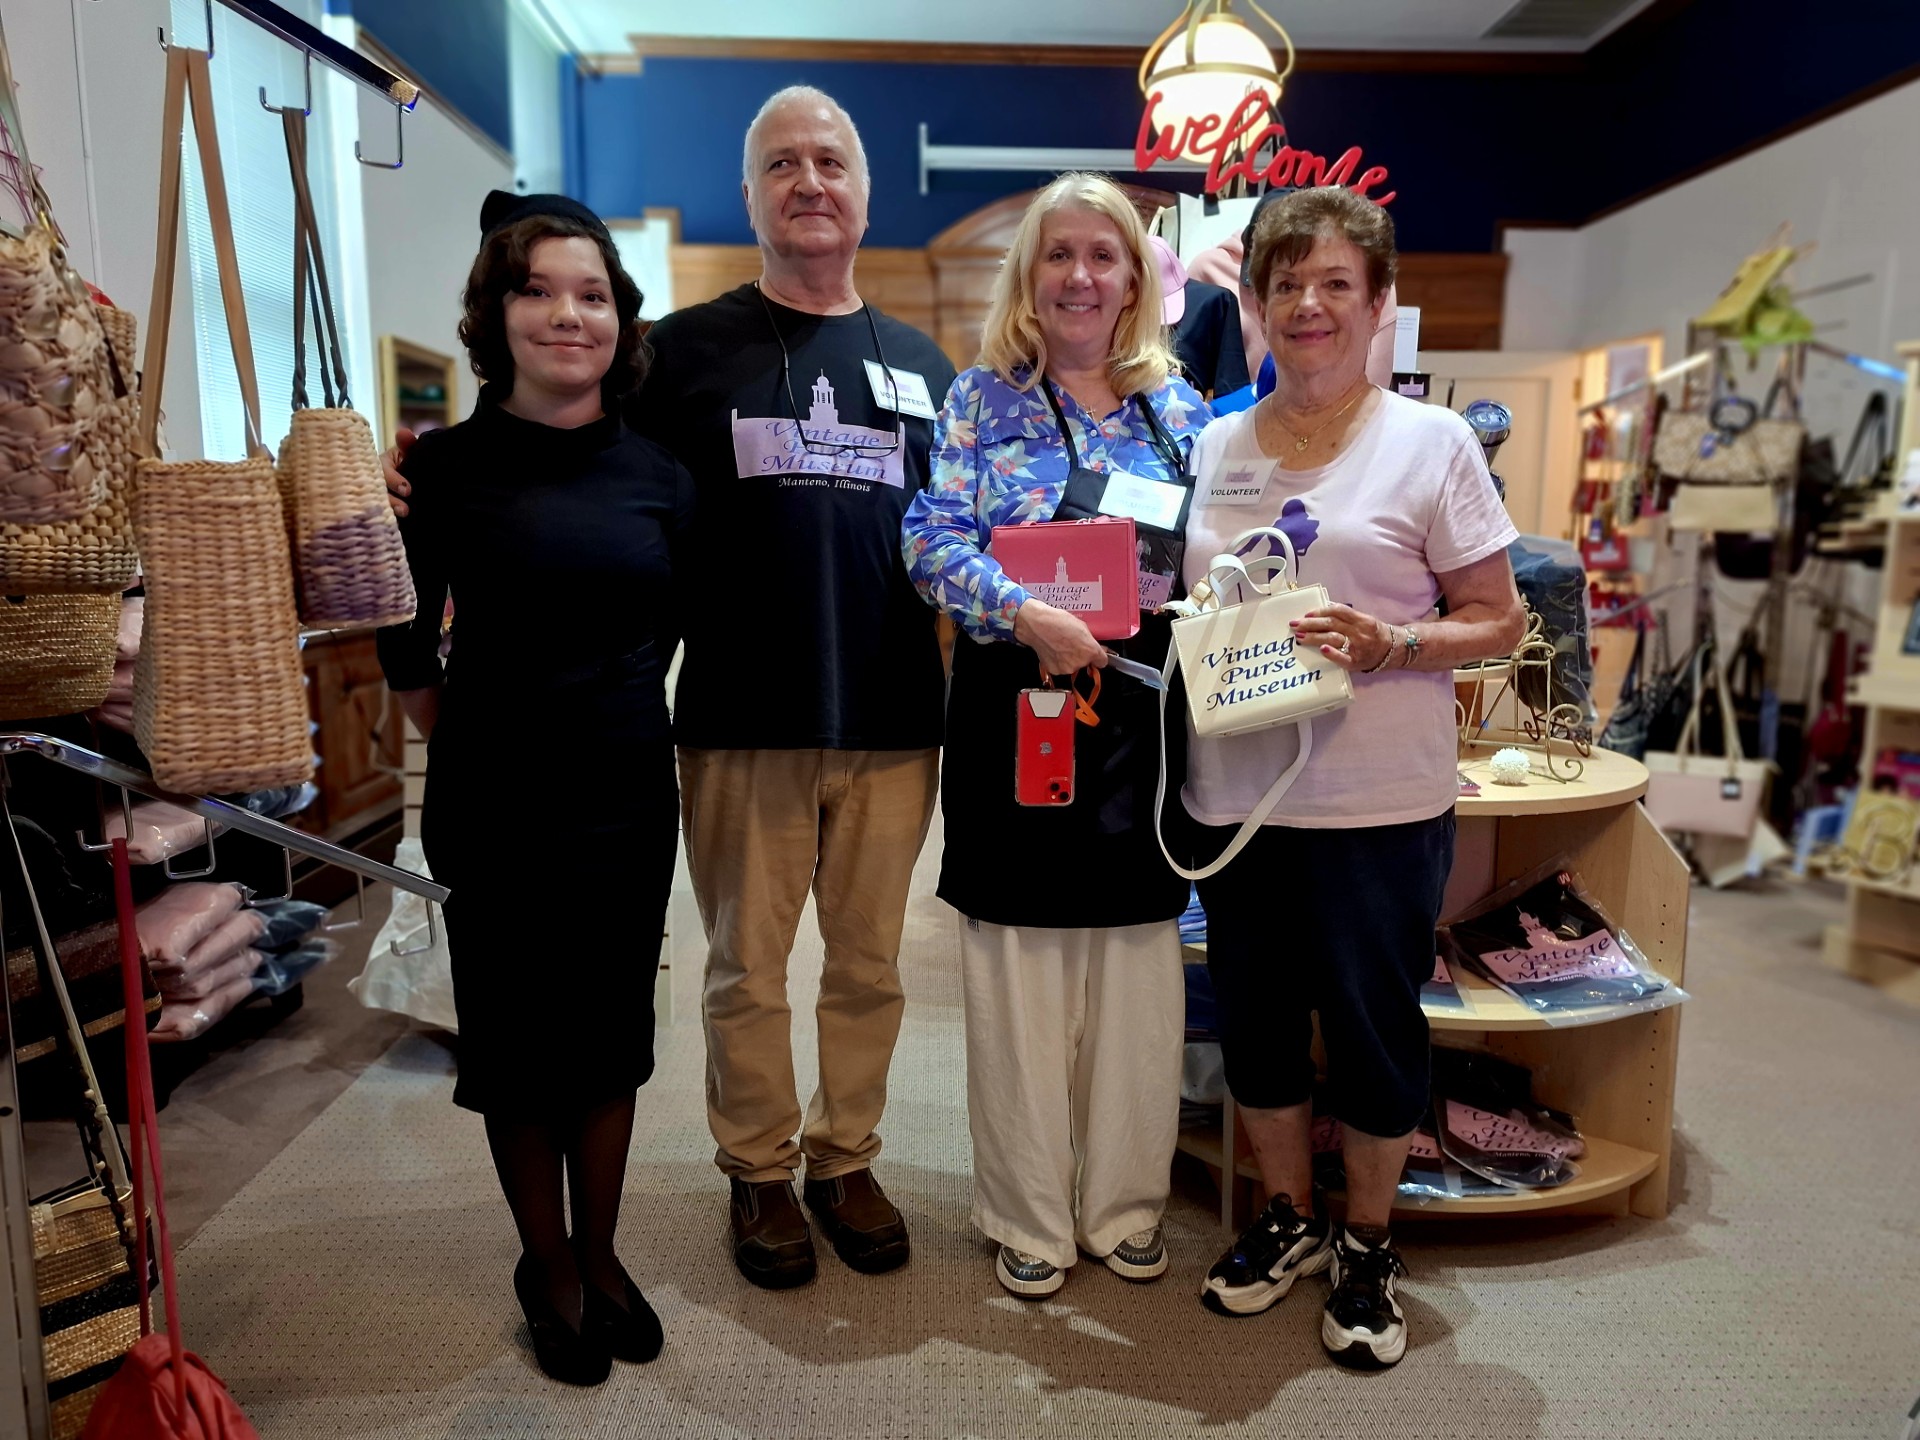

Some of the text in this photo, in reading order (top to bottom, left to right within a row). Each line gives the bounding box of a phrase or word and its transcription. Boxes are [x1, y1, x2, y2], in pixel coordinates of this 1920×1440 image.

[761, 454, 886, 480] Museum
[778, 477, 871, 492] Manteno, Illinois
[1211, 488, 1261, 496] VOLUNTEER
[1034, 584, 1090, 596] Vintage
[1043, 593, 1081, 602] Purse
[1201, 636, 1301, 669] Vintag
[1220, 656, 1297, 686] Purse
[1206, 669, 1323, 711] Museum
[1494, 937, 1610, 963] Vintage
